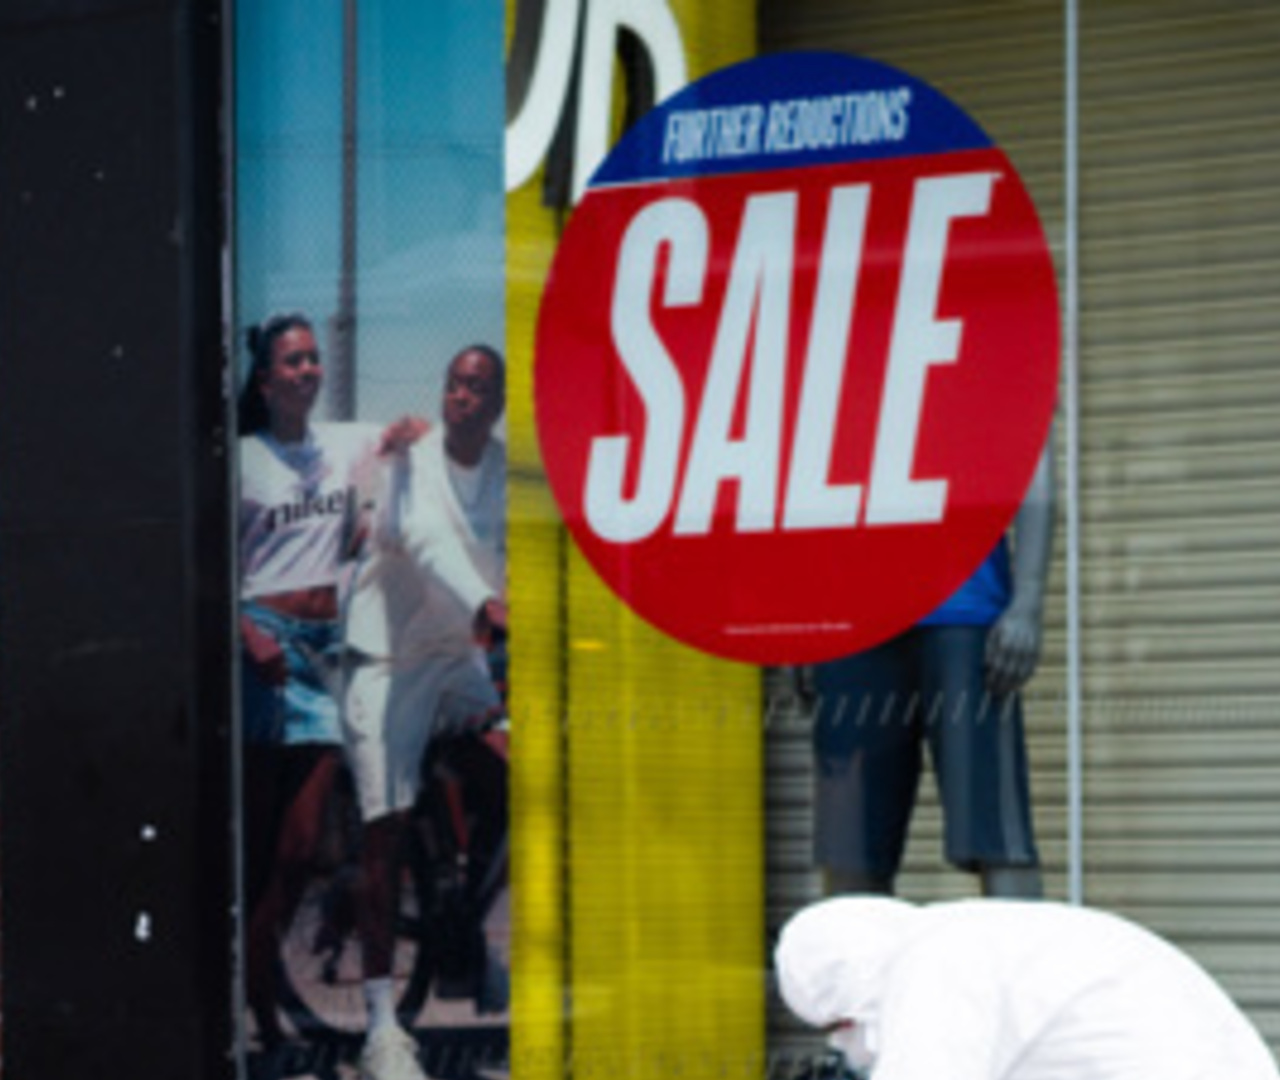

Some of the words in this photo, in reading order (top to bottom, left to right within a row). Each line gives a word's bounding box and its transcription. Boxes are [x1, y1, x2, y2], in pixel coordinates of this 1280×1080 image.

[662, 104, 763, 165] FURTHER
[765, 86, 911, 153] REDUCTIONS
[583, 171, 1004, 544] SALE
